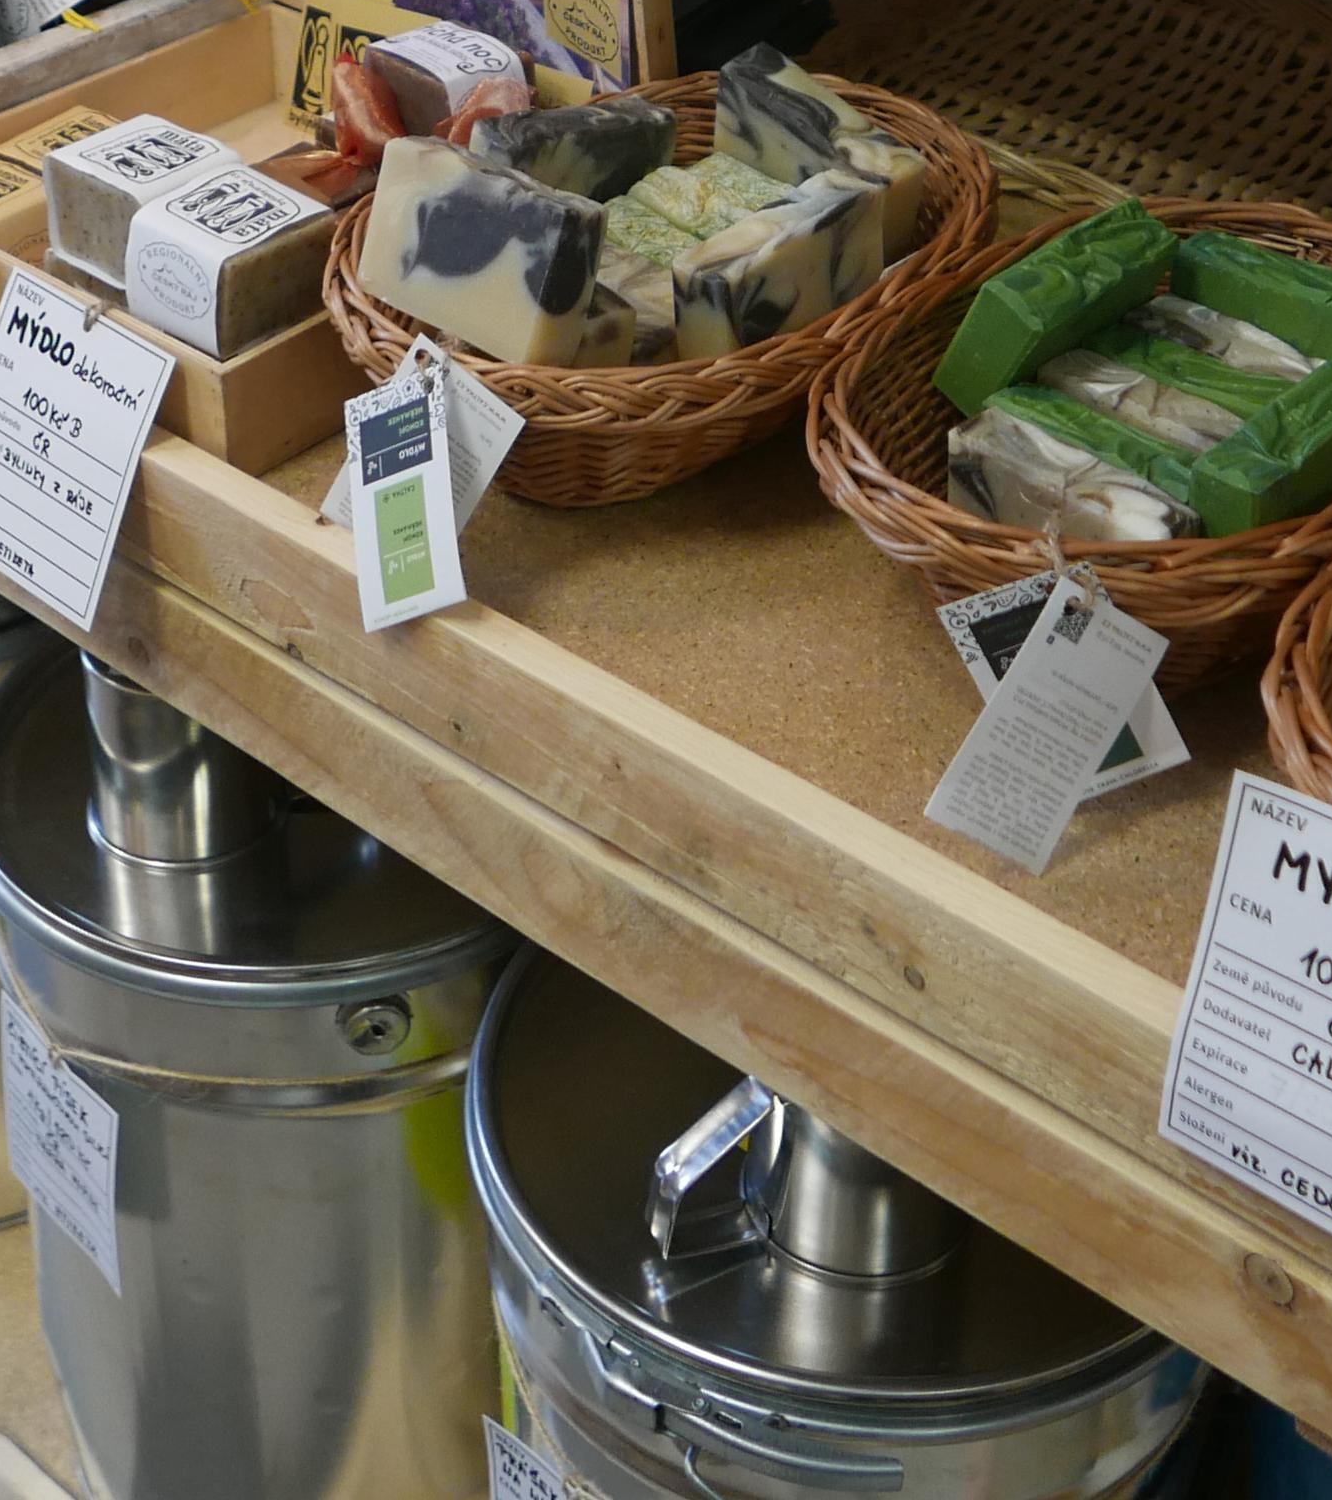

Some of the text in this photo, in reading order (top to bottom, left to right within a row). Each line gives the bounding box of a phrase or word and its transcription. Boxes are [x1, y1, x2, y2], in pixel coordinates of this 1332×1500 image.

[463, 41, 504, 70] noc
[157, 129, 205, 153] máta
[233, 210, 290, 238] máta
[16, 283, 46, 307] NÁZEV
[6, 305, 145, 411] MÝDLO dekorační
[22, 387, 48, 418] 100
[32, 430, 53, 459] ČR
[3, 446, 46, 491] BYLINKY
[65, 487, 94, 517] RÁJE
[1251, 797, 1309, 833] NÁZEV
[1229, 892, 1273, 925] CENA
[1212, 958, 1304, 1013] Země původu
[1202, 997, 1272, 1042] Dodavatel
[1192, 1035, 1249, 1075] Expirace
[1184, 1073, 1234, 1112] Alergen
[1178, 1108, 1226, 1145] Složení
